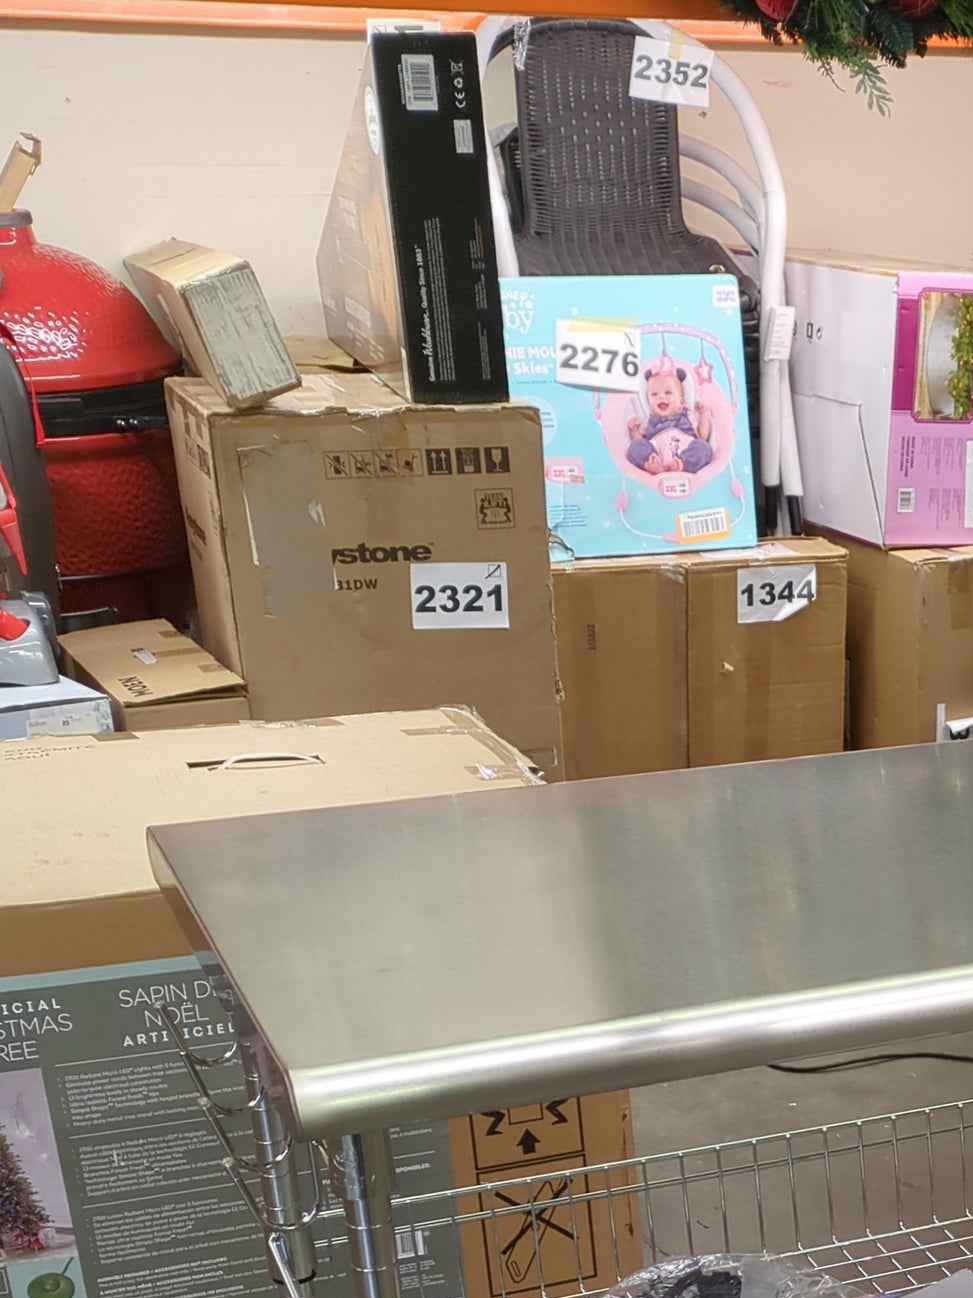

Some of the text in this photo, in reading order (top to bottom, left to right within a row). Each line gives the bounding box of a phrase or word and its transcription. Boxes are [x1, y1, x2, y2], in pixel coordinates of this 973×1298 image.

[634, 55, 708, 88] 2352
[503, 305, 534, 334] by
[560, 343, 639, 377] 2276
[415, 584, 503, 613] 2321
[741, 580, 815, 606] 1344
[117, 676, 153, 697] MOEN
[119, 983, 187, 1008] SAPIN
[123, 1022, 235, 1047] ARTIICIEL
